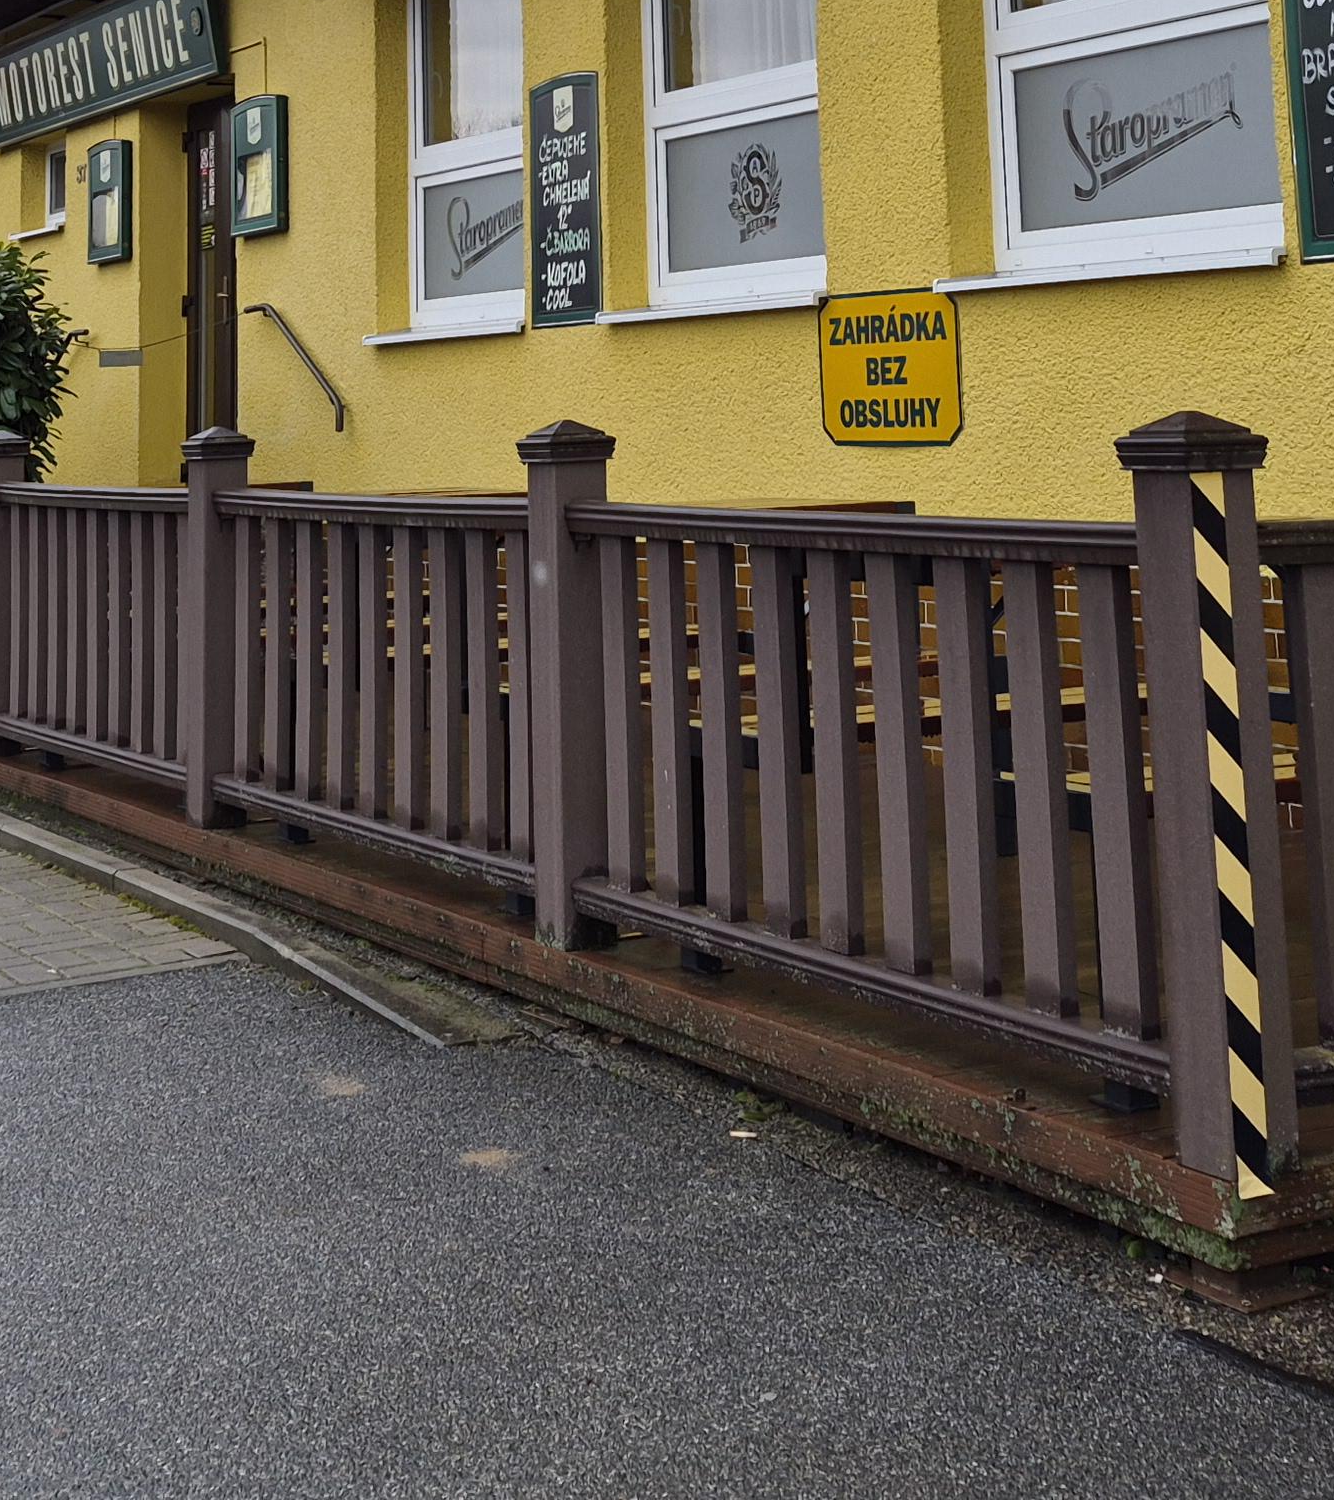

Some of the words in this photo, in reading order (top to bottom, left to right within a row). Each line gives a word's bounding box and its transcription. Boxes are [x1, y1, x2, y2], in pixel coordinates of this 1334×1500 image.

[828, 304, 948, 346] ZAHRÁDKA
[865, 355, 908, 386] BEZ
[839, 397, 942, 429] OBSLUHY
